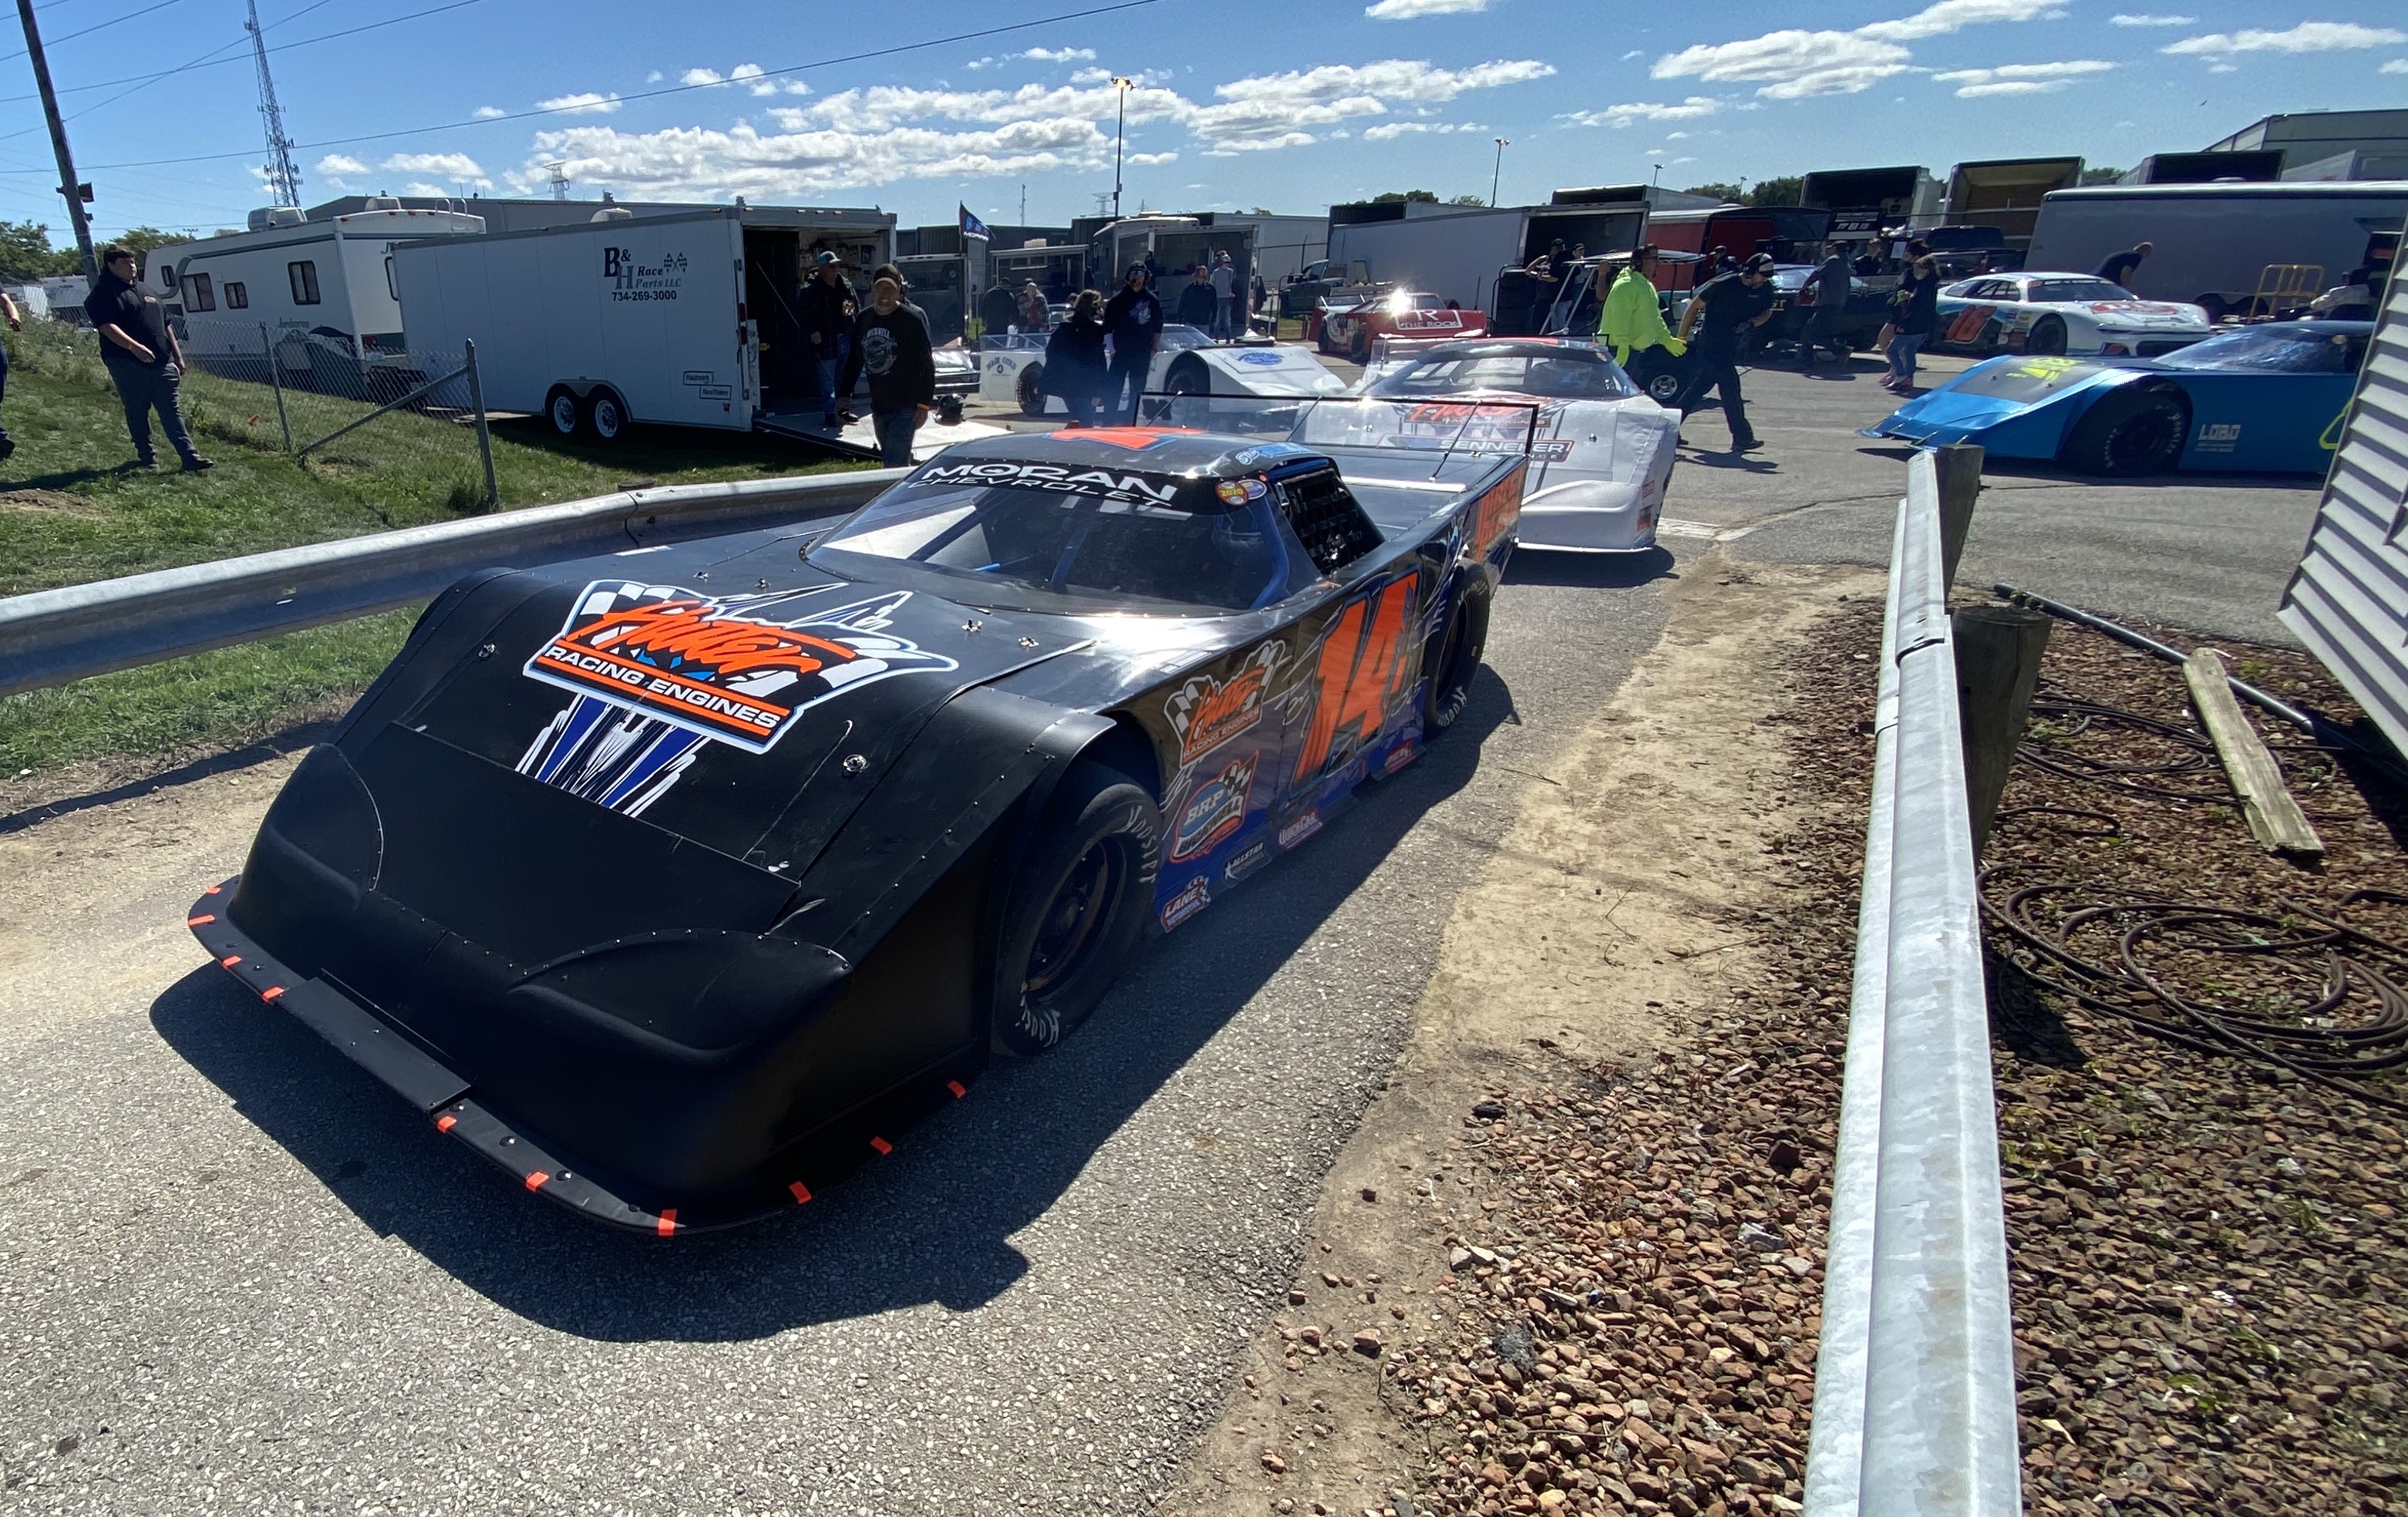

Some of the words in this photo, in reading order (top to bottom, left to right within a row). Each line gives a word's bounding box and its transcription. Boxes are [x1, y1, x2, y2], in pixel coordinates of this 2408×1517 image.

[604, 247, 621, 278] B
[621, 249, 631, 262] &
[615, 265, 635, 289] H
[635, 278, 663, 288] Parts
[665, 278, 682, 288] LLC
[637, 265, 663, 276] Race
[611, 290, 677, 301] 734-269-3000
[2198, 424, 2241, 440] LOBO
[908, 476, 1173, 507] CHEVROLET
[921, 464, 1178, 501] MORAN
[1220, 488, 1244, 497] 2020
[544, 645, 647, 684] RACING
[647, 677, 782, 728] ENGINES
[1295, 570, 1419, 782] 14
[1182, 732, 1220, 758] RACING
[1221, 705, 1260, 735] ENGINES
[1183, 788, 1226, 827] BRP
[1232, 841, 1265, 866] ALLSTAR
[1164, 888, 1199, 918] LANE
